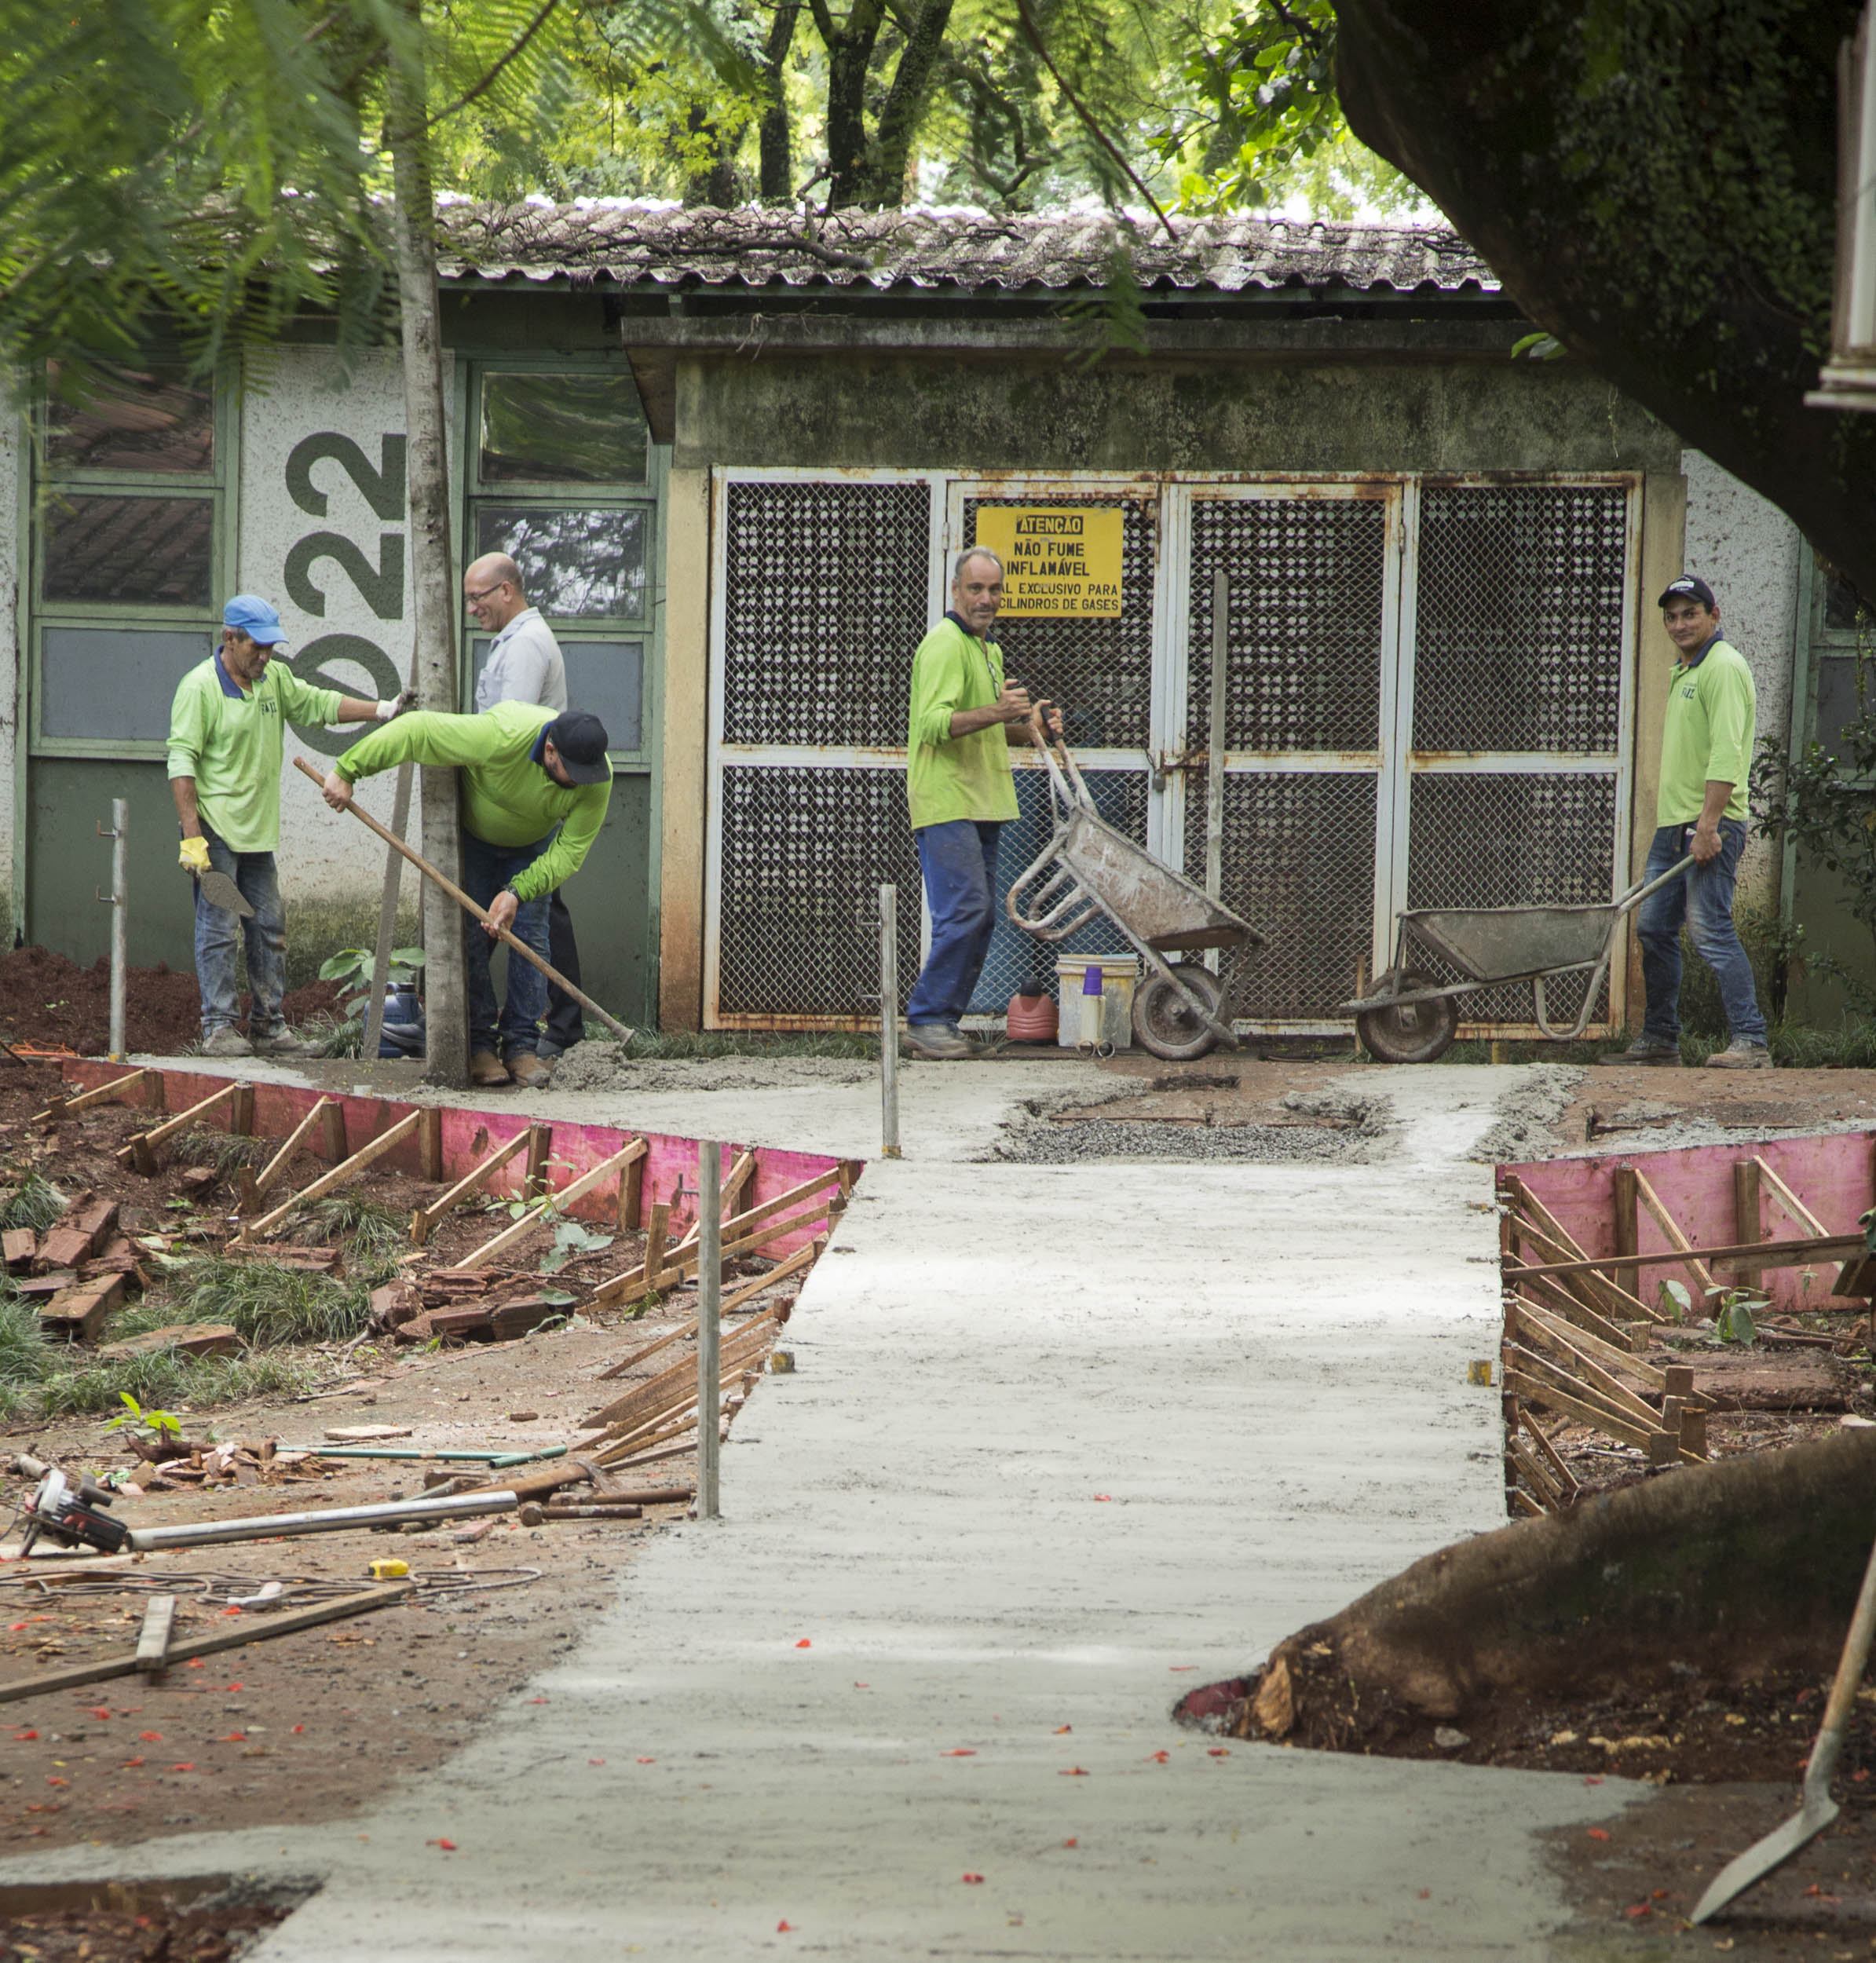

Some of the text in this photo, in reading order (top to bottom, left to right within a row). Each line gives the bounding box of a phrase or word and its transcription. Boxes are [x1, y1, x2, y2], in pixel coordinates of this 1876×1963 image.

[1020, 515, 1081, 535] ATENÇÃO
[1014, 538, 1084, 557] NÃO FUME
[1007, 557, 1090, 576] INFLAMÁVEL
[1018, 583, 1081, 595] EXCLUSIVO
[1088, 583, 1118, 596] PARA
[999, 598, 1119, 610] CILINDROS DE GASES
